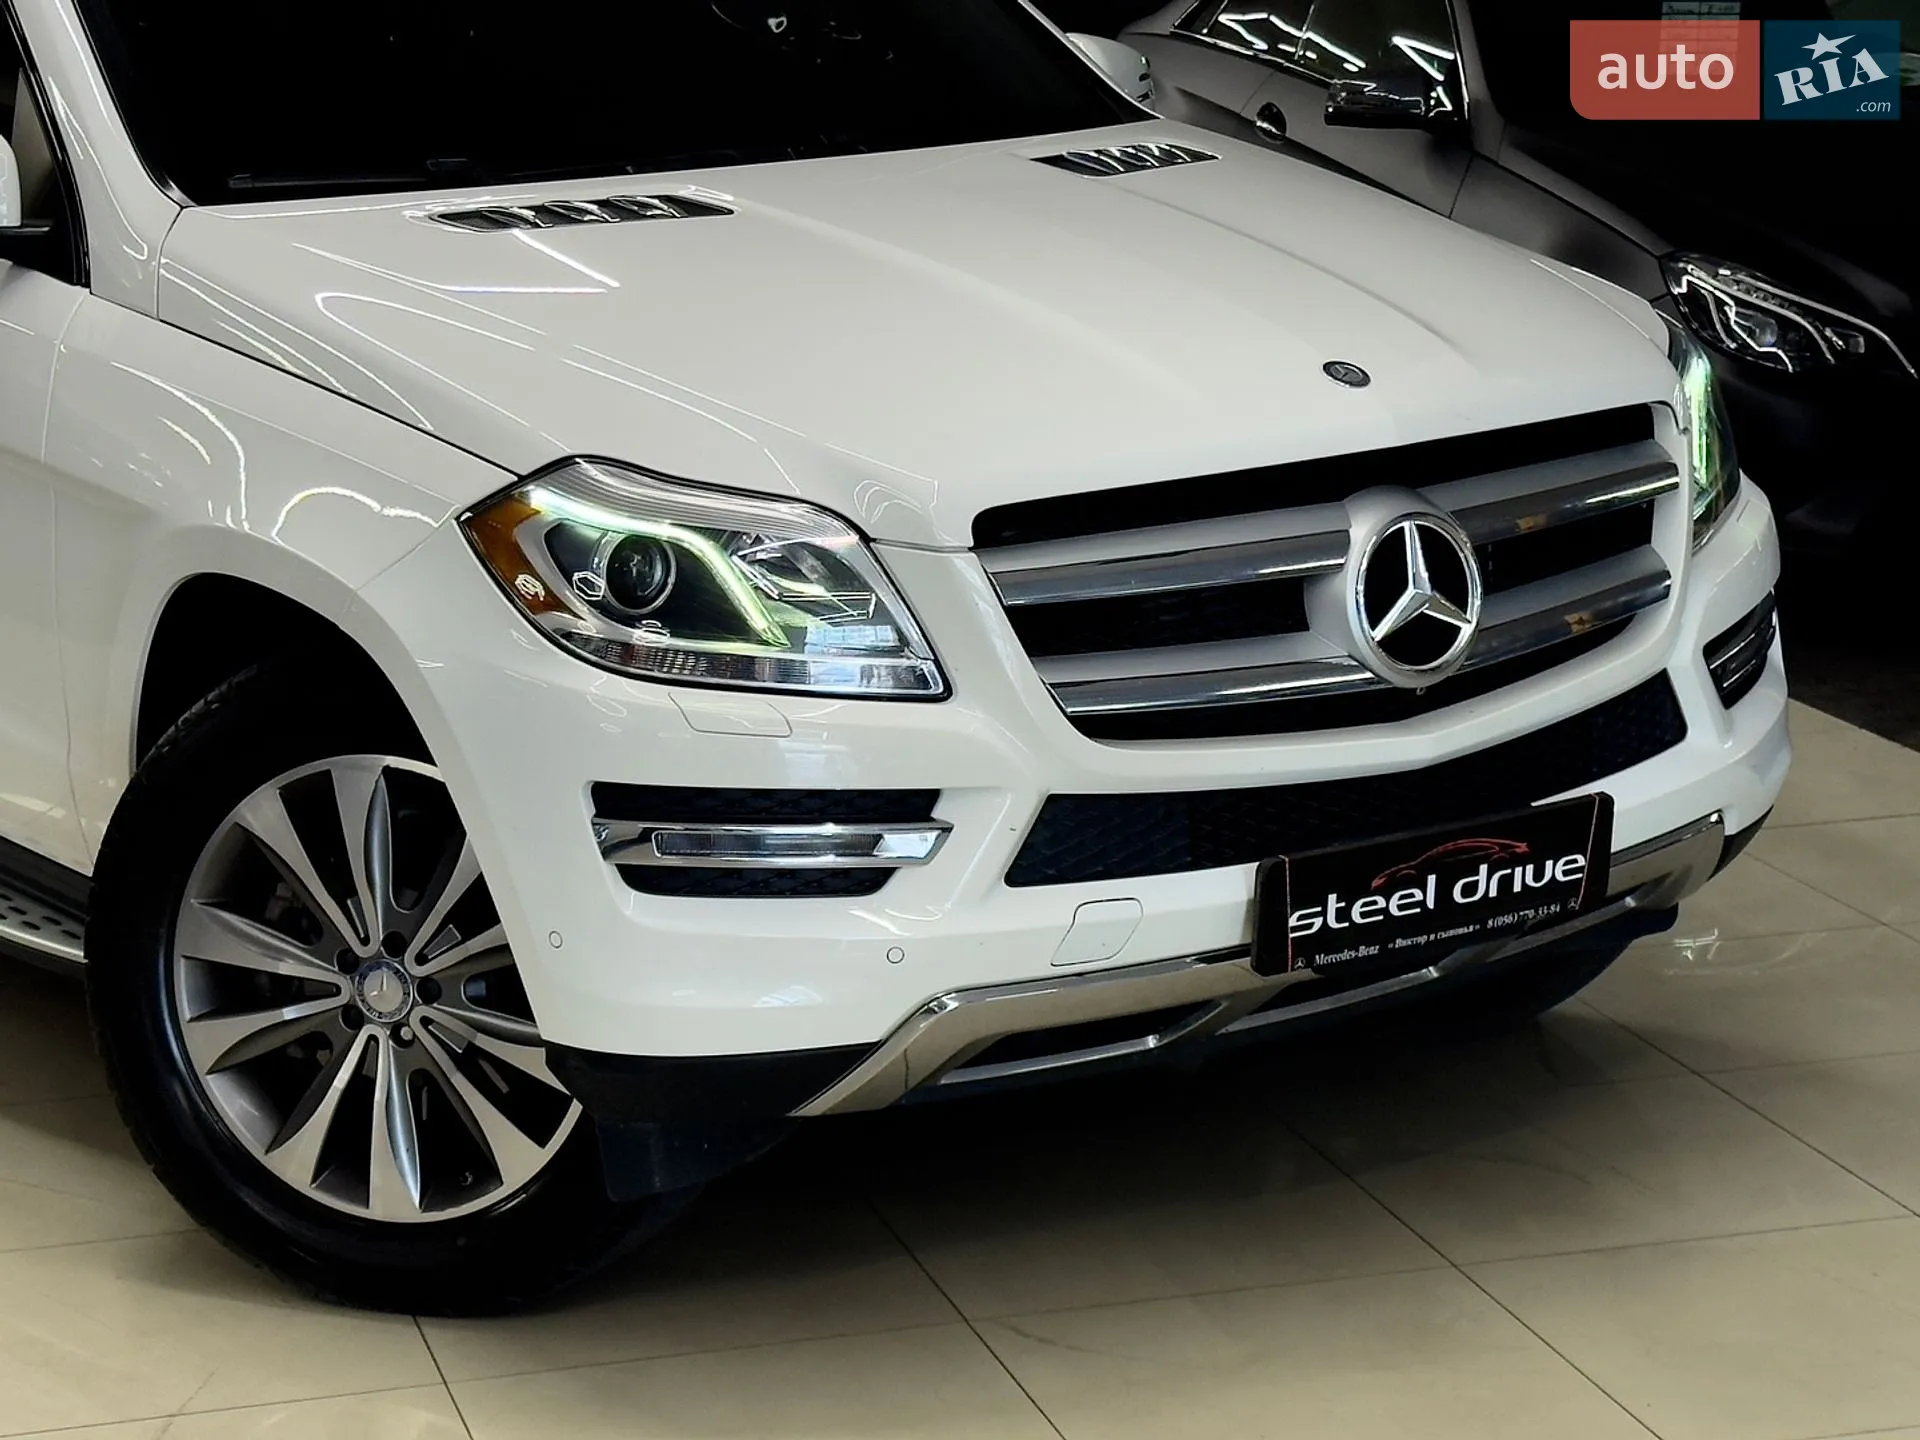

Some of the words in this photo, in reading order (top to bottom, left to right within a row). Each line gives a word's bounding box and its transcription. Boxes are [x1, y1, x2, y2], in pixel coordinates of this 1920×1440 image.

[1289, 873, 1435, 938] steel
[1453, 853, 1587, 905] drive
[1313, 944, 1380, 967] Mercedes-Benz
